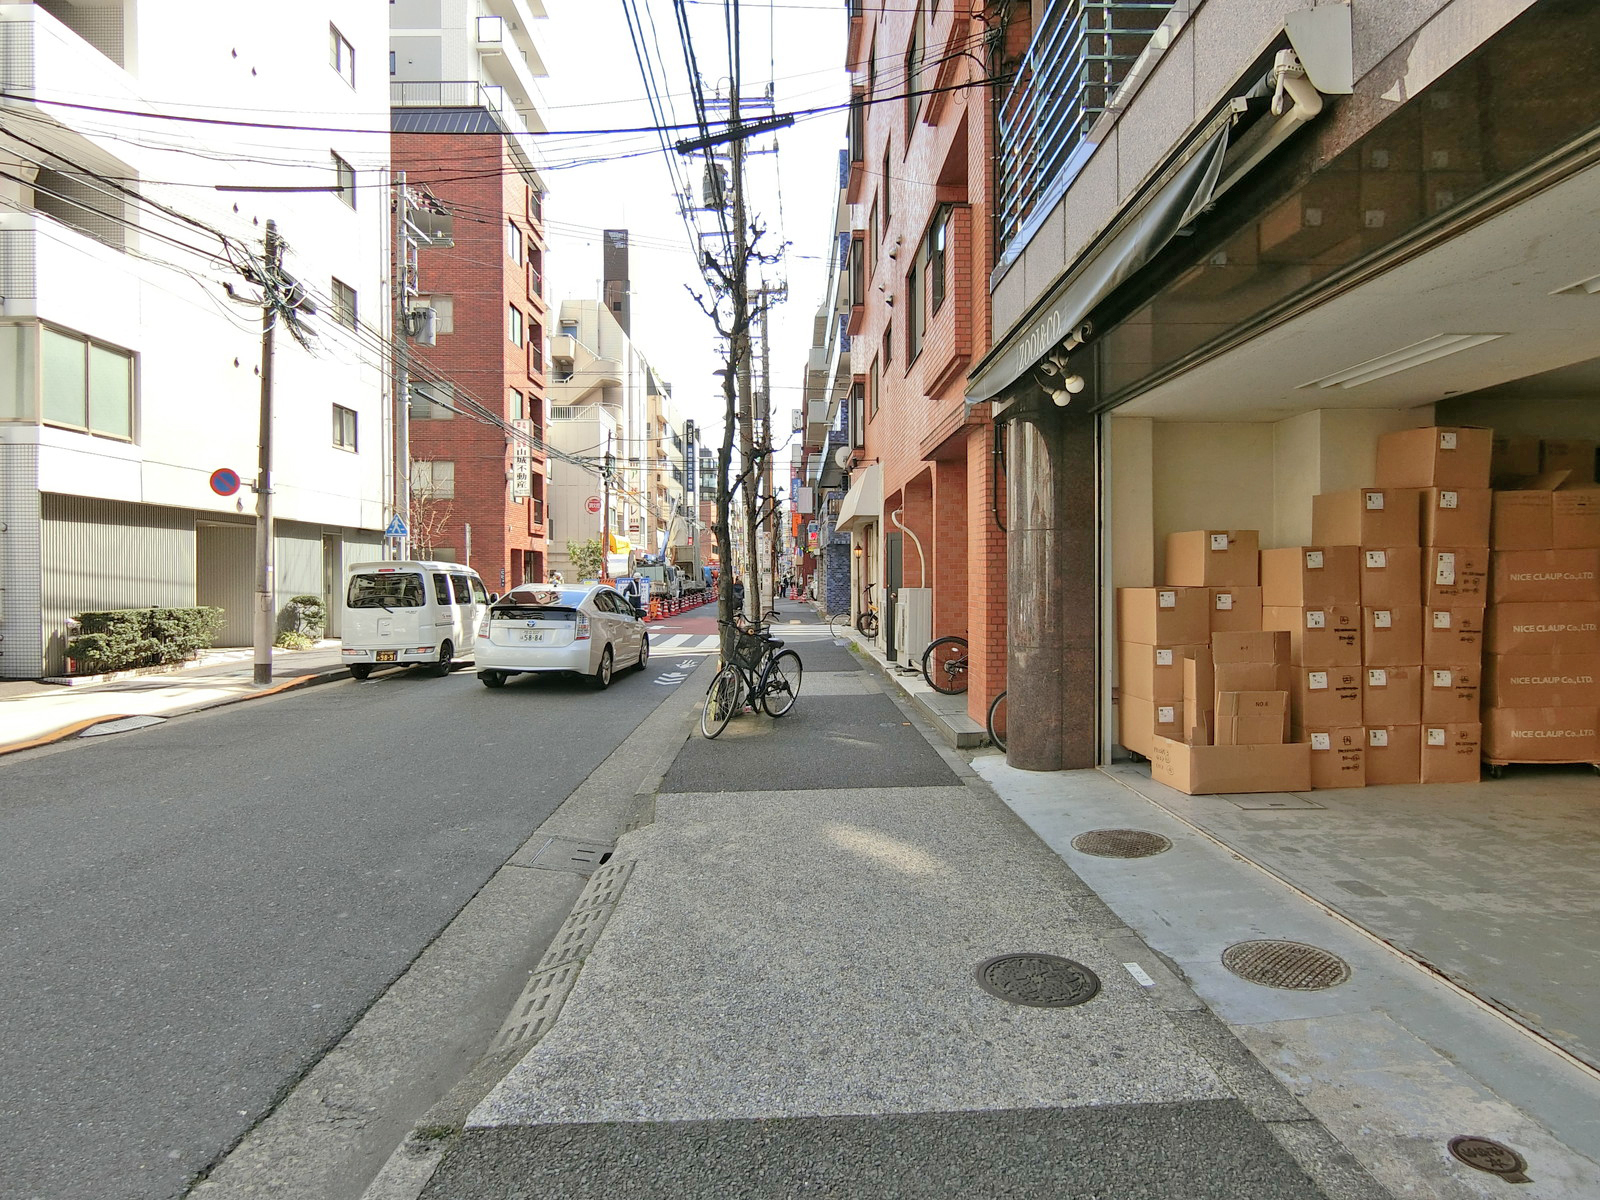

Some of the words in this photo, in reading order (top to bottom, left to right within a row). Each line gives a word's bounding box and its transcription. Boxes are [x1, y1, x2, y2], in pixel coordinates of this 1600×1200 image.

[516, 448, 528, 489] 山城不動産
[1510, 573, 1532, 581] NICE
[1533, 572, 1562, 580] CLAUP
[1536, 624, 1566, 632] CLAUP
[1531, 676, 1560, 684] CLAUP
[1511, 730, 1534, 738] NICE
[1534, 730, 1564, 738] CLAUP
